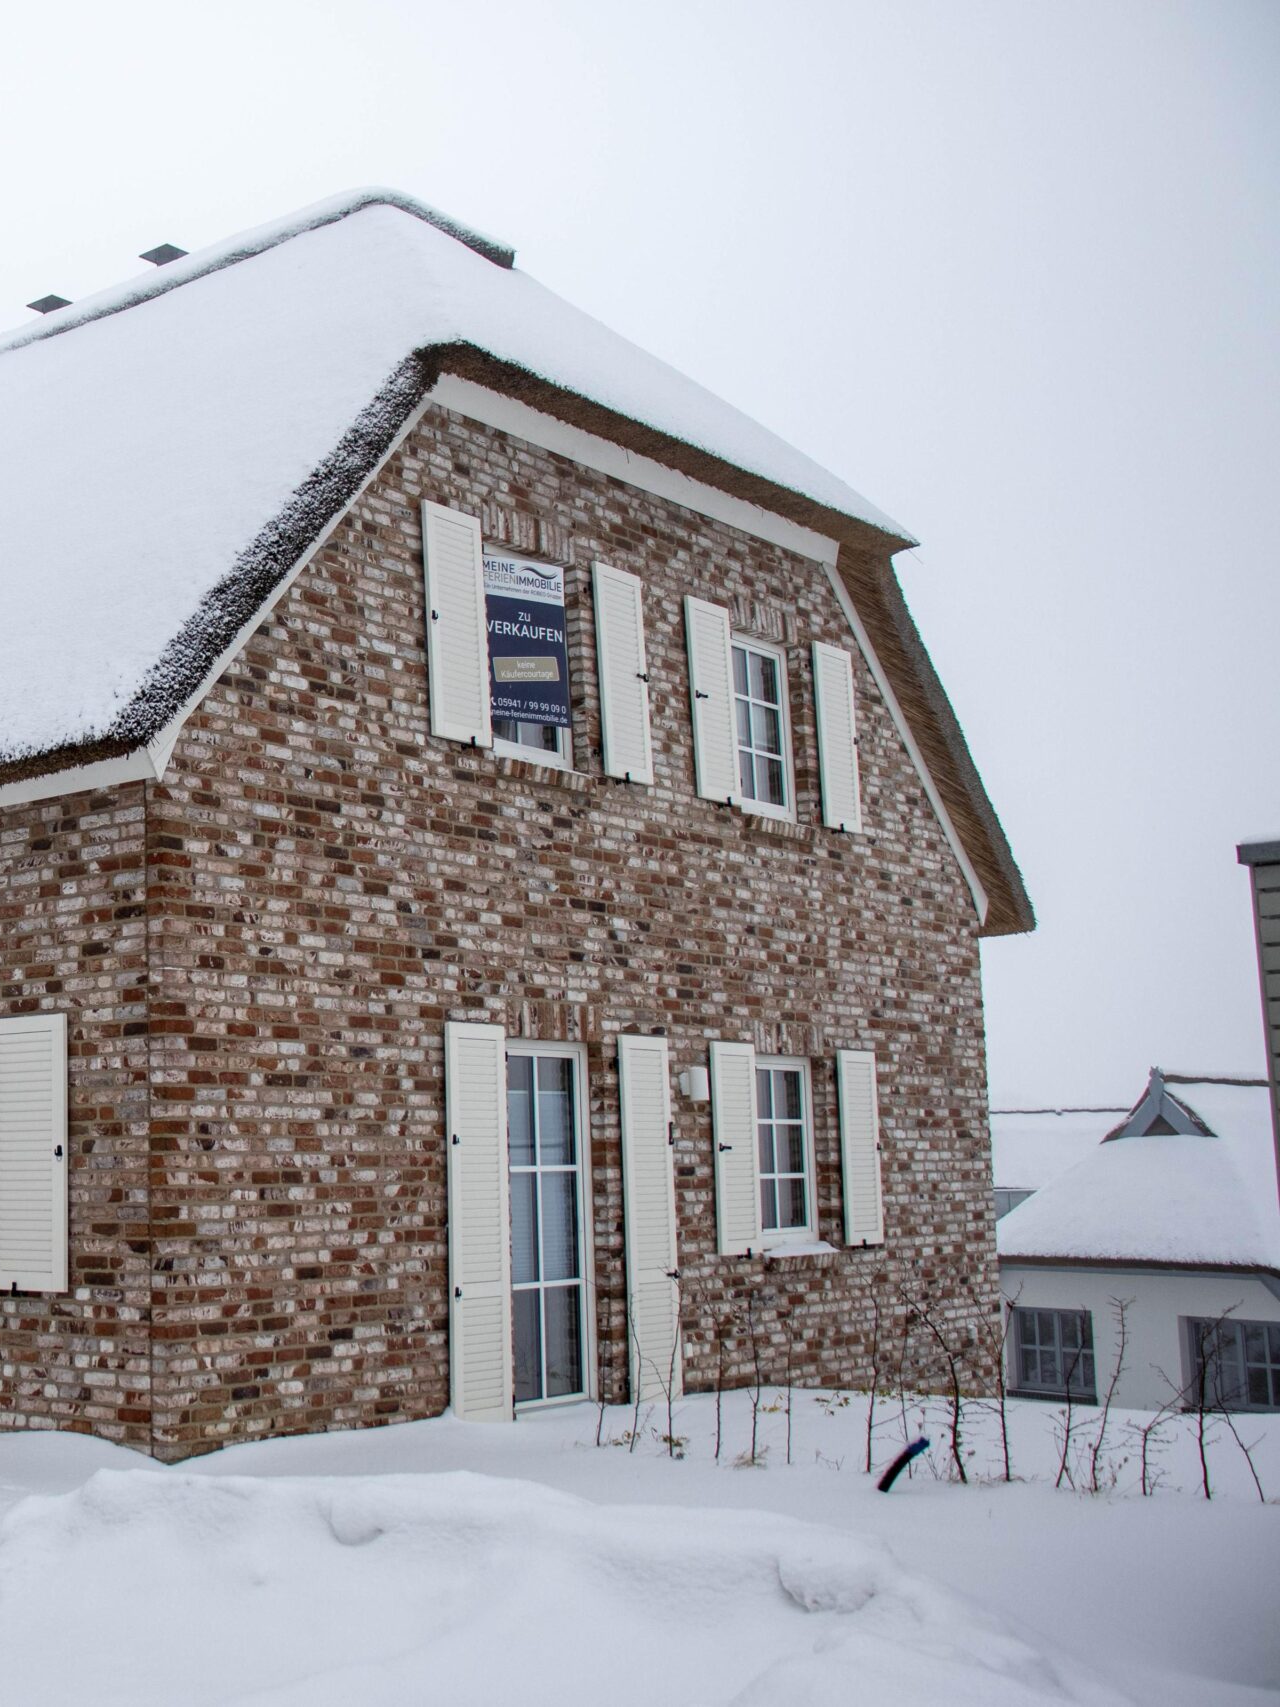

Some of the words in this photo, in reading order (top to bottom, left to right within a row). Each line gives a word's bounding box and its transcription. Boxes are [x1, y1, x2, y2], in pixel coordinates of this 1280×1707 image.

[483, 560, 516, 574] MEINE
[483, 571, 562, 593] FERIENIMMOBILIE
[486, 620, 563, 643] VERKAUFEN
[516, 660, 536, 669] keine
[500, 669, 554, 680] Käufercourtage
[498, 697, 521, 708] 05941
[528, 701, 539, 711] 99
[540, 702, 550, 712] 99
[551, 704, 560, 713] 09
[561, 706, 567, 714] 0
